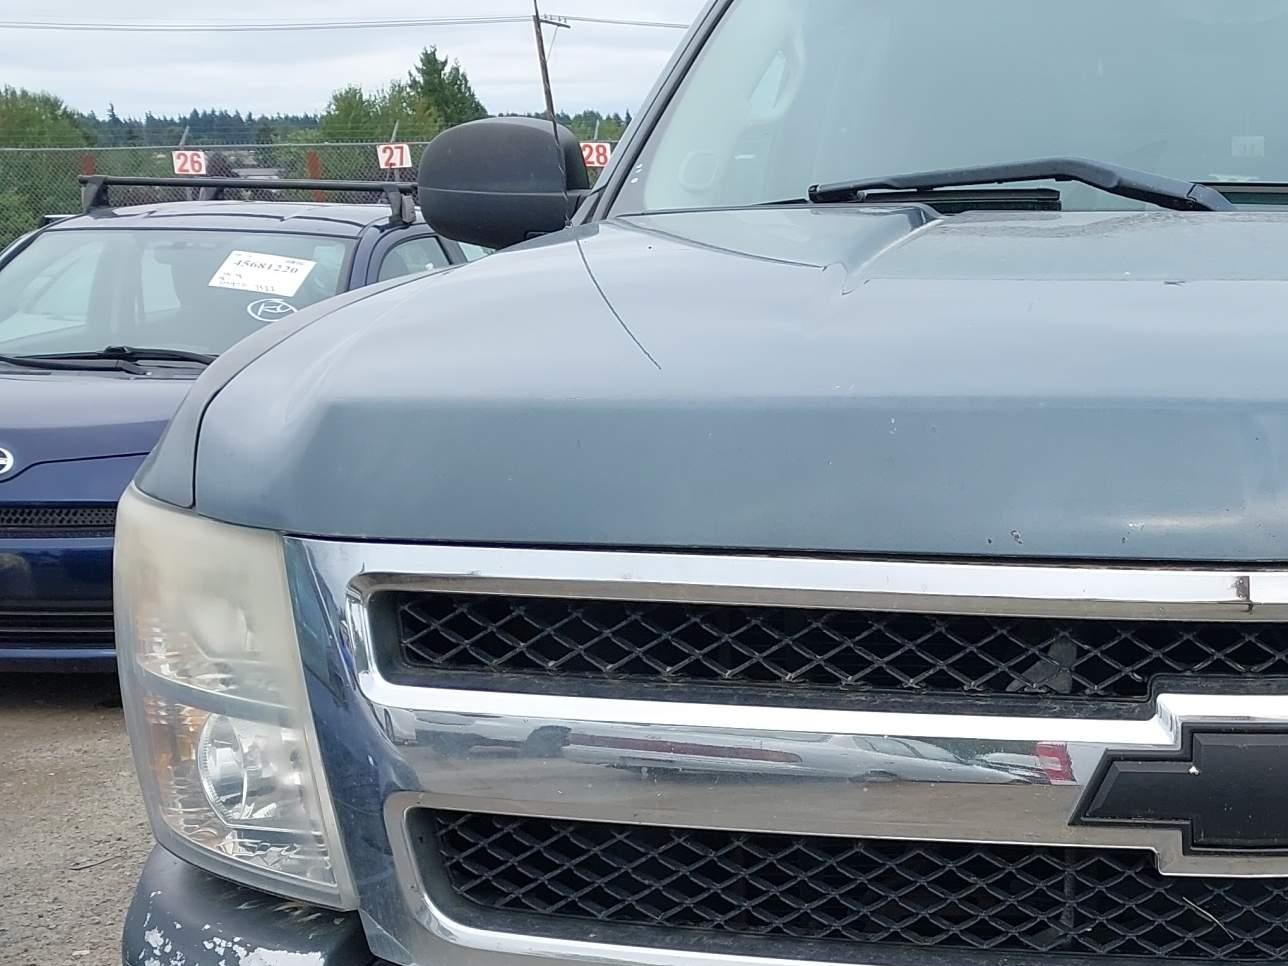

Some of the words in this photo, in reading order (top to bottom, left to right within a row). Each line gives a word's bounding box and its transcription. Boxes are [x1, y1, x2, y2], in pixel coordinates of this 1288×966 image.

[176, 152, 203, 173] 26
[381, 145, 404, 167] 27
[582, 143, 608, 165] 28
